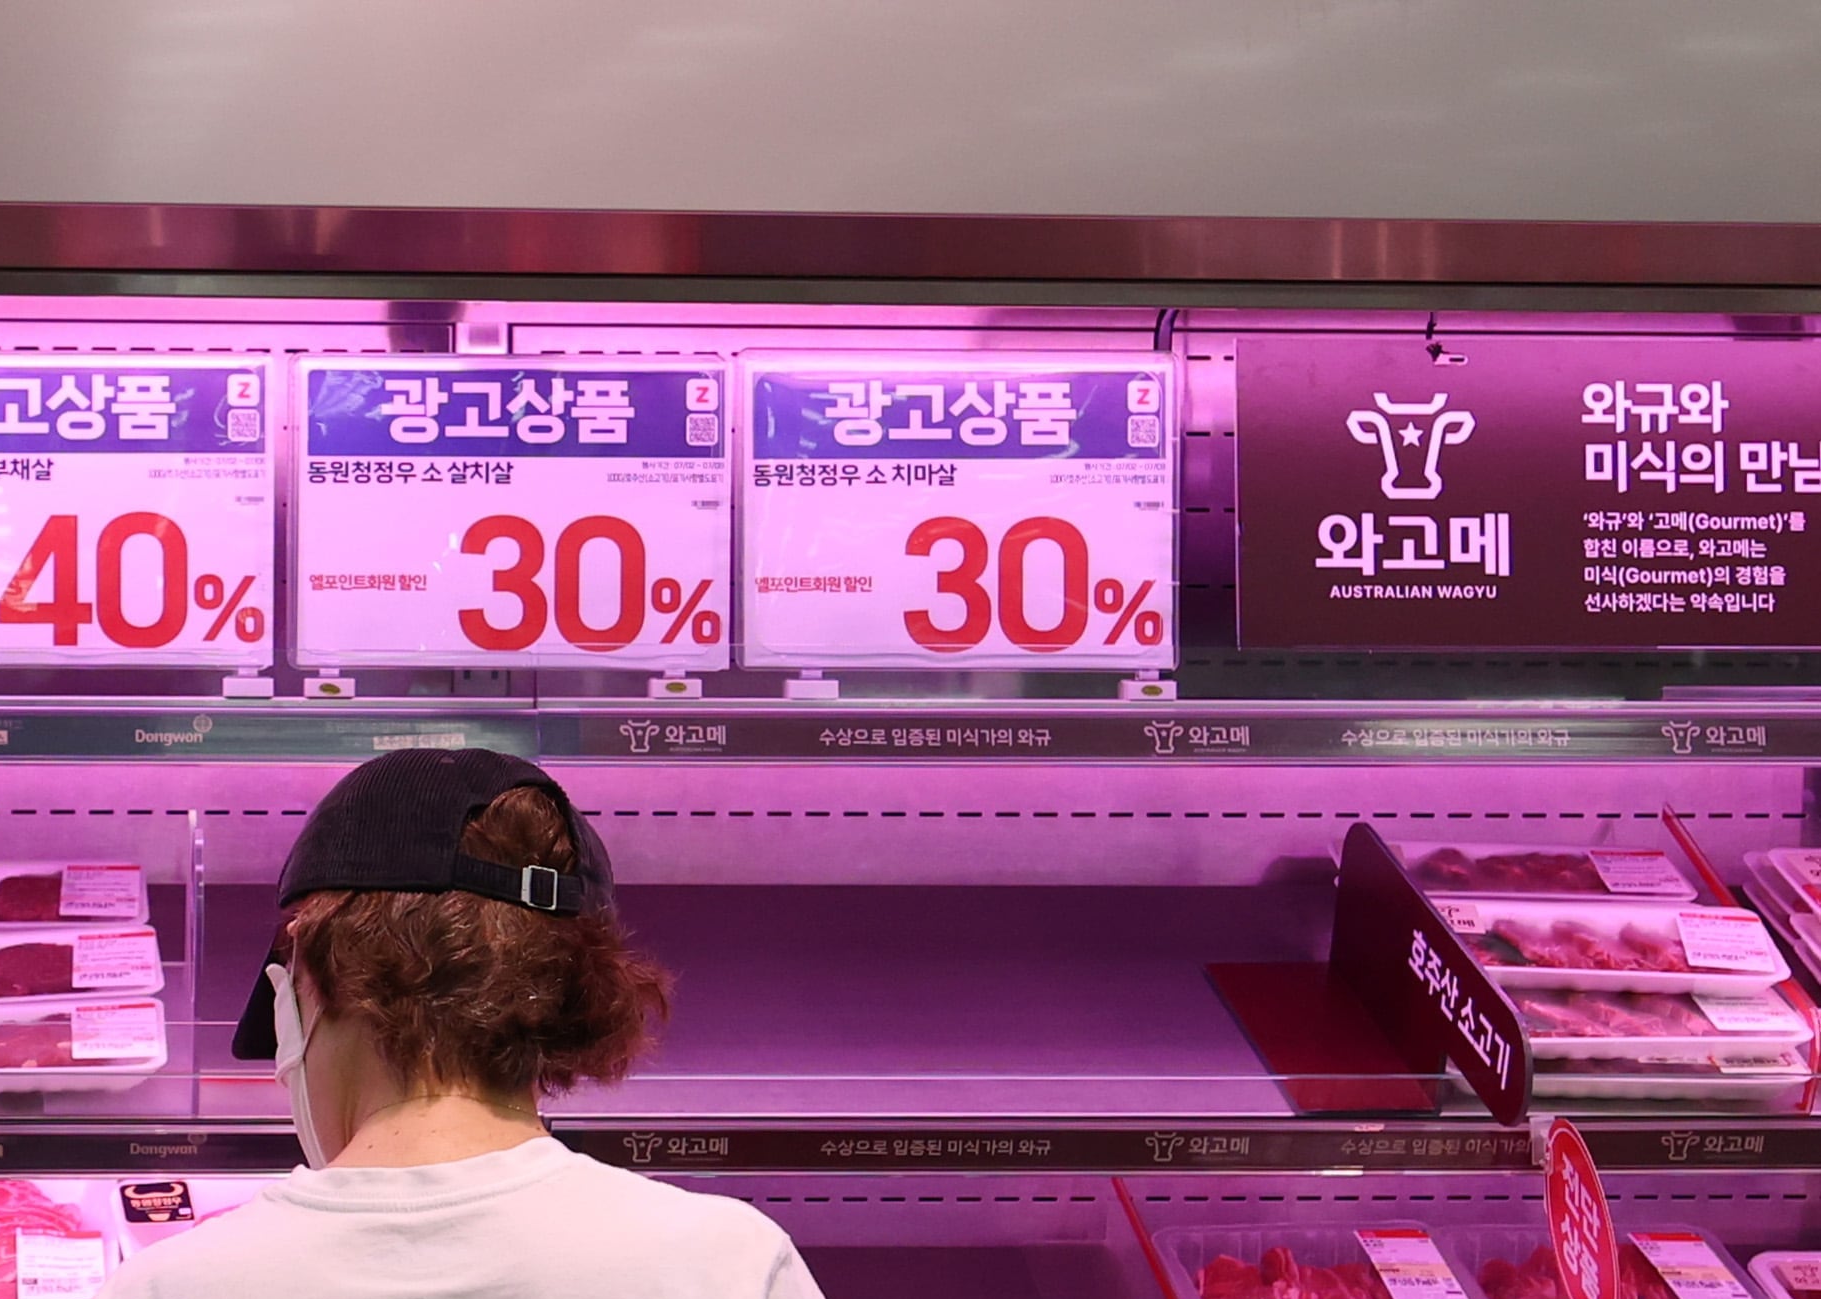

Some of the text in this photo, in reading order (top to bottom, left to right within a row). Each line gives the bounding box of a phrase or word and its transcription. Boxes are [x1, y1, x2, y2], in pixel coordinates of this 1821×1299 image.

[381, 377, 635, 445] 광고상품
[825, 379, 1077, 447] 광고상품
[1581, 380, 1729, 434] 와규와
[307, 461, 514, 484] 동원청정우 소 살치살
[752, 464, 957, 487] 동원청정우 소 치마살
[1584, 441, 1725, 493] 미식의
[1315, 512, 1511, 577] 와고메
[1583, 539, 1767, 560] 합친 이름으로, 와고메는
[398, 574, 427, 592] 할인
[458, 515, 721, 652] 30%
[843, 576, 873, 593] 할인
[904, 516, 1163, 653] 30%
[1584, 566, 1787, 588] 미식(Gourmet)의 경험을
[1330, 585, 1497, 599] AUSTRALIAN WAGYU
[1584, 592, 1775, 613] 선사하겠다는 약속입니다
[134, 729, 204, 746] Dongwon
[664, 724, 726, 745] 와고메
[819, 727, 1052, 747] 수상으로 입증된 미식가의 와규
[1188, 726, 1251, 747] 와고메
[1341, 728, 1571, 748] 수상으로 입증된 미식가의 와규
[1705, 725, 1767, 747] 와고메
[1407, 929, 1460, 1023] 호주산
[1458, 996, 1512, 1091] 소고기
[129, 1143, 198, 1157] Dongwon
[668, 1136, 729, 1156] 와고메
[820, 1138, 1052, 1157] 수상으로 입증된 미식가의 와규
[1188, 1136, 1250, 1156] 와고메
[1704, 1135, 1765, 1154] 와고메
